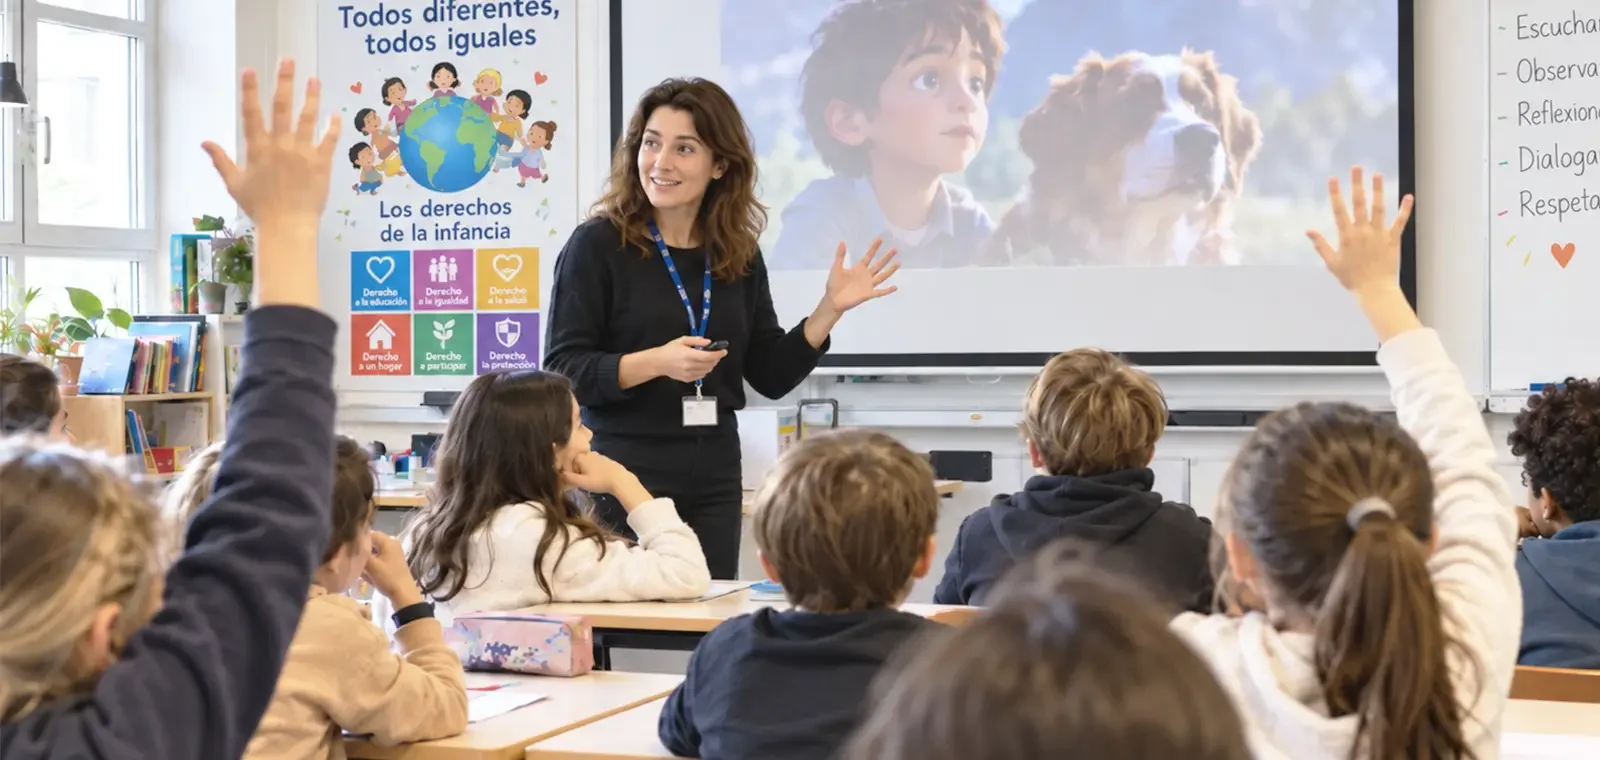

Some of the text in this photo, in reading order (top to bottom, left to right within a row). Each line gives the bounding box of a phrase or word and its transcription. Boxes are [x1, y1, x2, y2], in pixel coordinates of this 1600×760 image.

[338, 0, 559, 28] Todos diferentes,
[365, 22, 537, 56] todos iguales
[1517, 58, 1600, 84] Observa
[1518, 100, 1600, 126] Reflexion
[1519, 143, 1600, 176] Dialoga
[380, 198, 512, 219] Los derechos
[380, 222, 511, 242] de la infancia
[363, 287, 398, 297] Derecho
[426, 286, 462, 296] Derecho
[362, 351, 399, 361] Derecho
[425, 350, 462, 361] Derecho
[489, 351, 526, 360] Derecho
